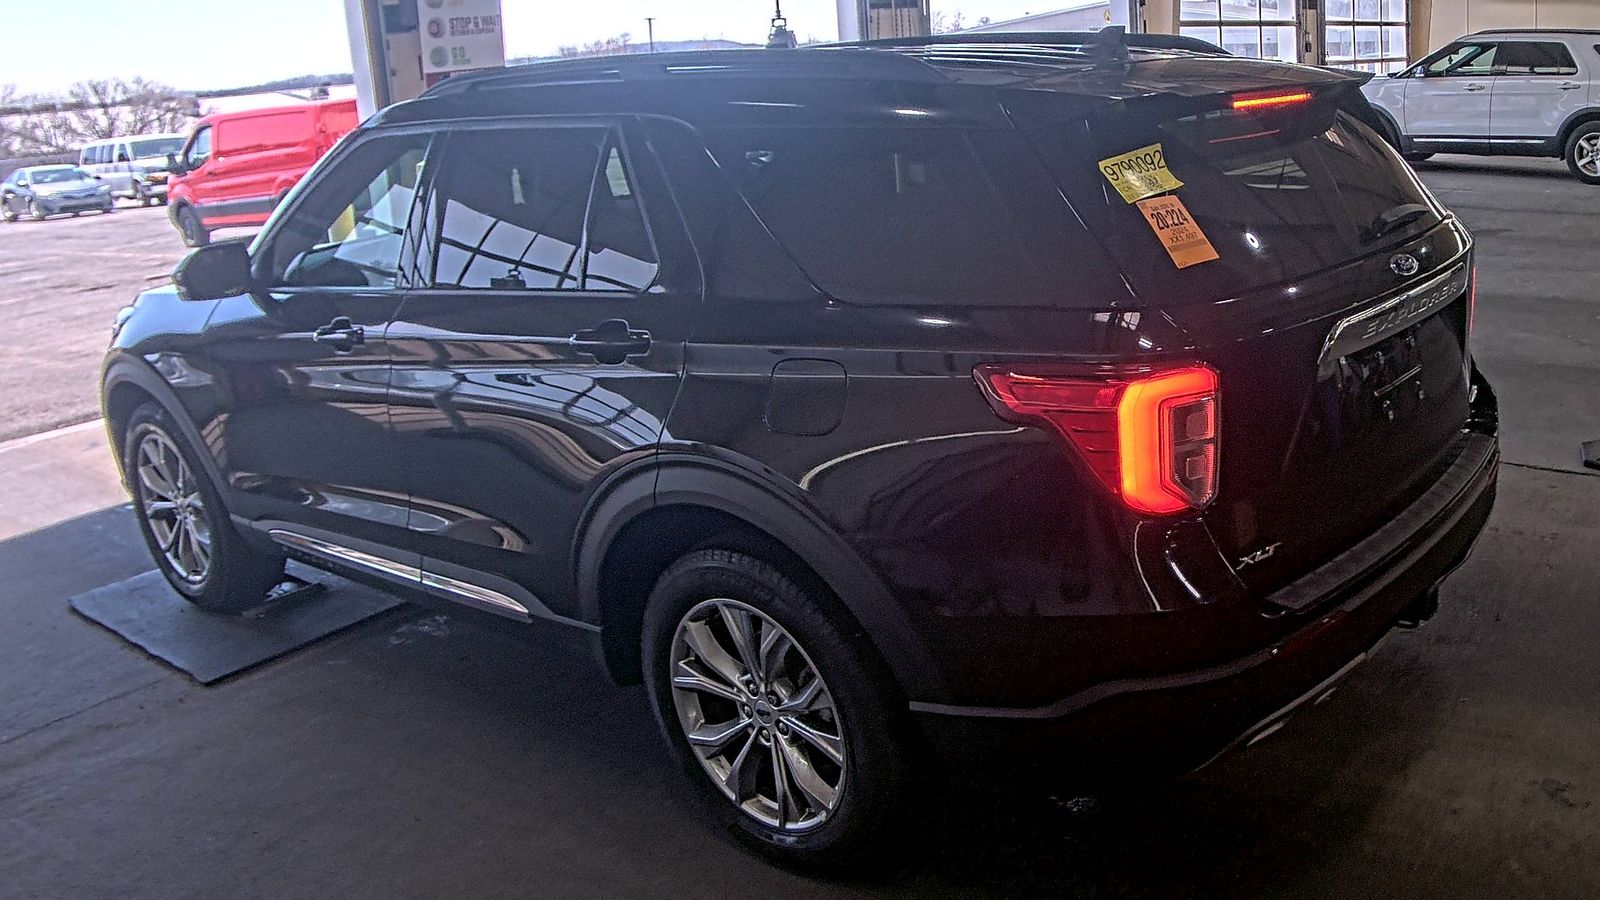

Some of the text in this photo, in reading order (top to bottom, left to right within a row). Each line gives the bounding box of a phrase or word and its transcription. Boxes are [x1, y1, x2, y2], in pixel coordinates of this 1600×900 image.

[448, 16, 472, 29] STOP
[480, 14, 501, 27] WAIT
[451, 46, 465, 59] GO
[1103, 149, 1166, 182] 9790092
[1361, 280, 1458, 340] EXPLORER
[1235, 541, 1282, 570] XLT
